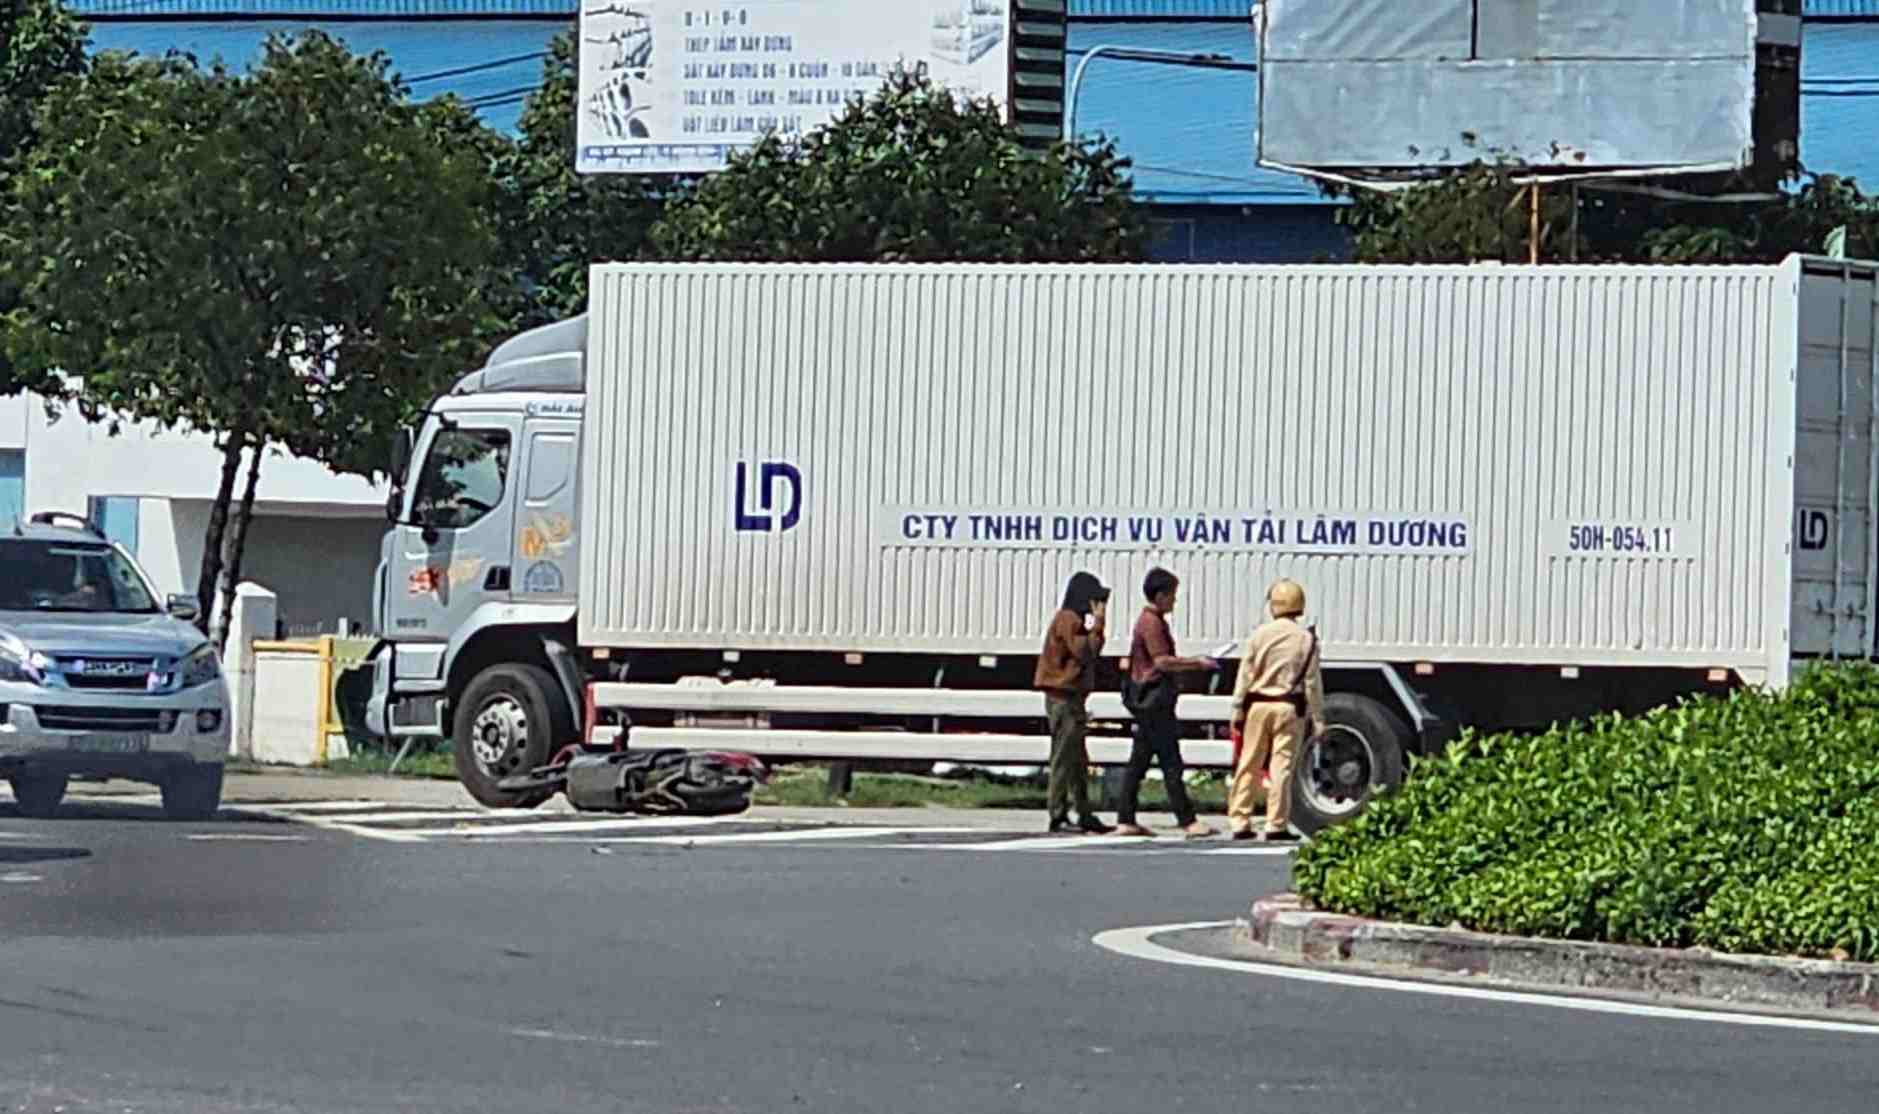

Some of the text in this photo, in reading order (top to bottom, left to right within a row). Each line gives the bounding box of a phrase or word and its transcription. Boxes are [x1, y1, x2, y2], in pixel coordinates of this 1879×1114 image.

[736, 461, 802, 532] LD
[902, 509, 1467, 549] CTY TNHH DỊCH VỤ VẬN TẢI LÂM DƯƠNG
[1569, 525, 1672, 552] 50H-054.11
